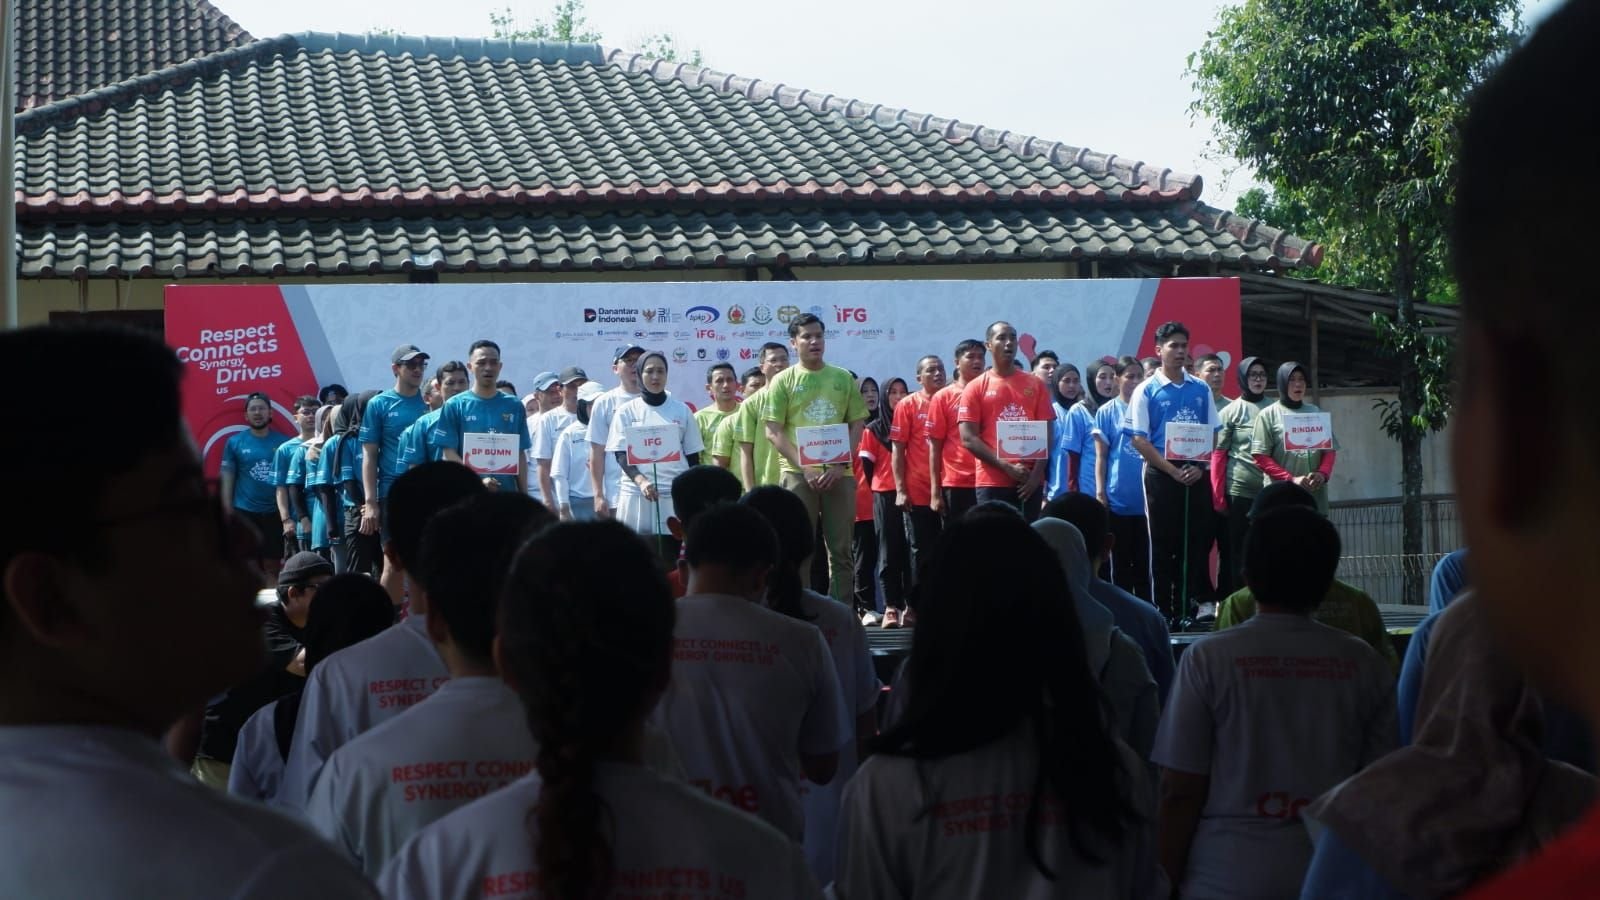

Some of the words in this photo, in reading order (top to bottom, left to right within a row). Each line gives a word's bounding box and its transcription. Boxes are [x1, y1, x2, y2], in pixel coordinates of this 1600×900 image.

[598, 307, 639, 315] Danantara
[200, 322, 275, 344] Respect
[176, 338, 278, 363] Connects
[200, 358, 244, 371] Synergy
[216, 364, 282, 384] Drives
[216, 387, 229, 395] us
[1291, 426, 1324, 434] RINDAM
[644, 437, 662, 447] IFG
[806, 439, 842, 447] JAMDATUN
[471, 448, 483, 456] BP
[484, 448, 512, 456] BUMN
[700, 639, 762, 652] CONNECTS
[369, 679, 426, 694] RESPECT
[392, 761, 468, 783] RESPECT
[404, 782, 488, 802] SYNERGY
